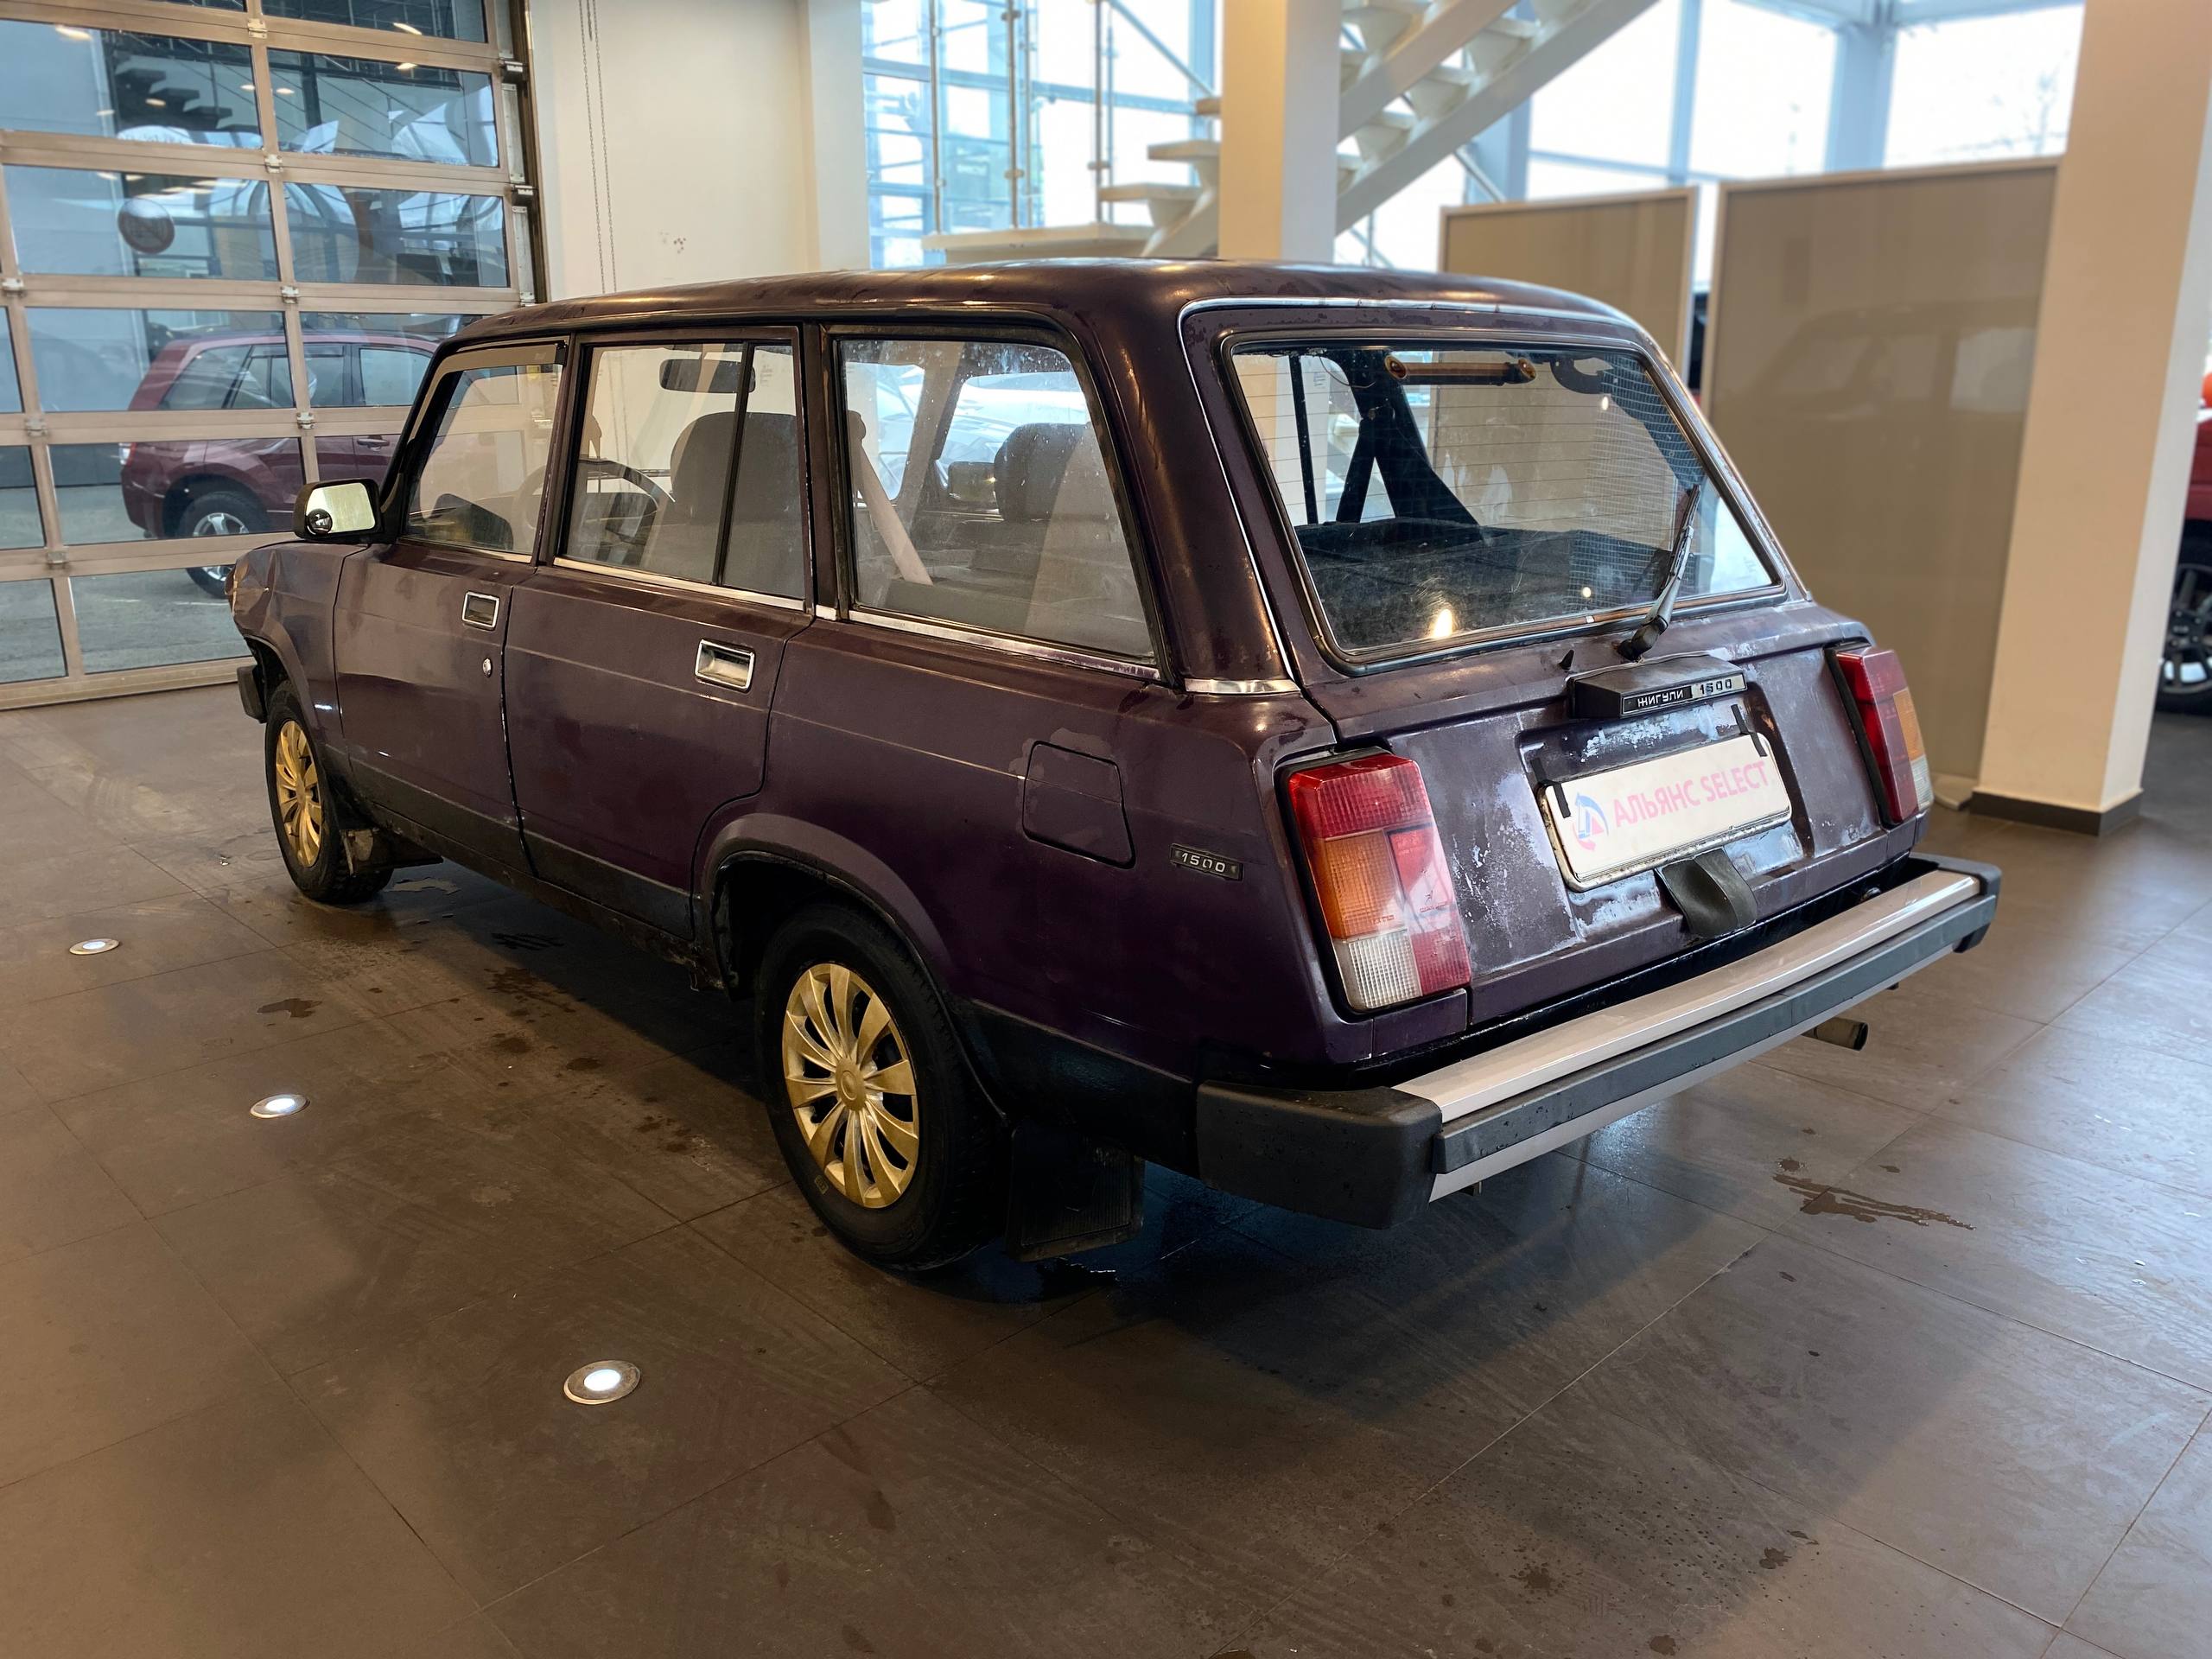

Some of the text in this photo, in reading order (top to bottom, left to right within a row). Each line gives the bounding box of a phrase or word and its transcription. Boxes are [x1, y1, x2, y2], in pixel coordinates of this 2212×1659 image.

[1637, 690, 1684, 708] ЖИГУЛИ
[1612, 760, 1770, 827] АЛЬЯНС SELECT
[1181, 852, 1226, 873] 1500
